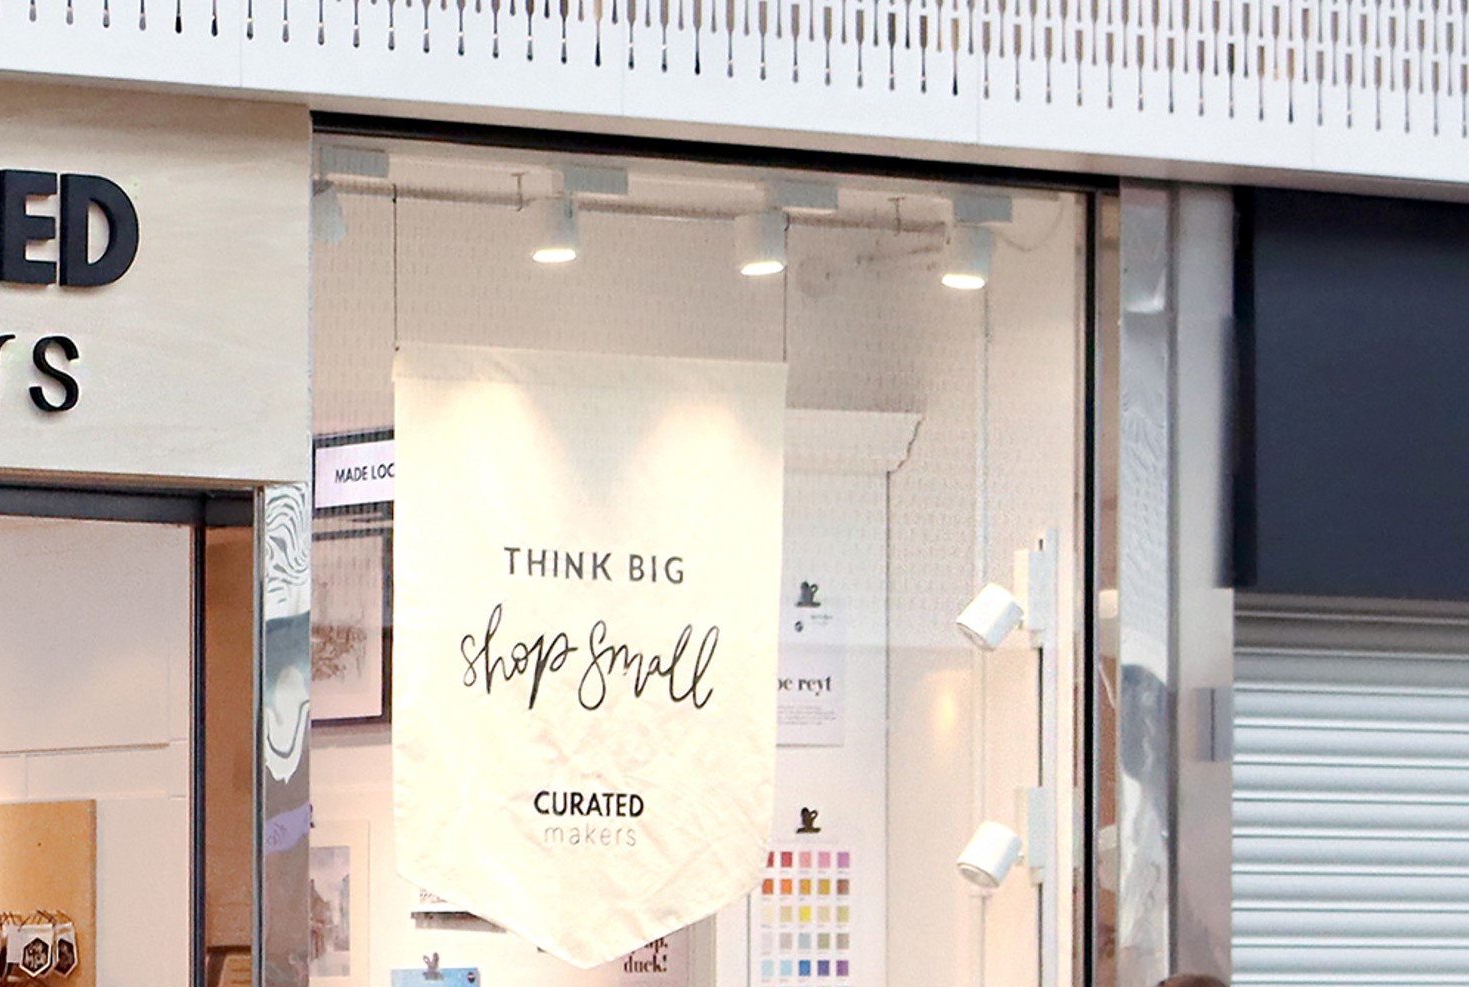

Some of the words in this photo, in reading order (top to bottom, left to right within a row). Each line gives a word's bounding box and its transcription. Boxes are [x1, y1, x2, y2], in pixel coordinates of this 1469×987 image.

[335, 465, 368, 483] MADE
[503, 546, 613, 582] THINK
[628, 553, 685, 584] BIG
[461, 602, 579, 710] shop
[533, 790, 644, 818] CURATED
[543, 822, 637, 848] makers
[623, 954, 668, 973] duck!
